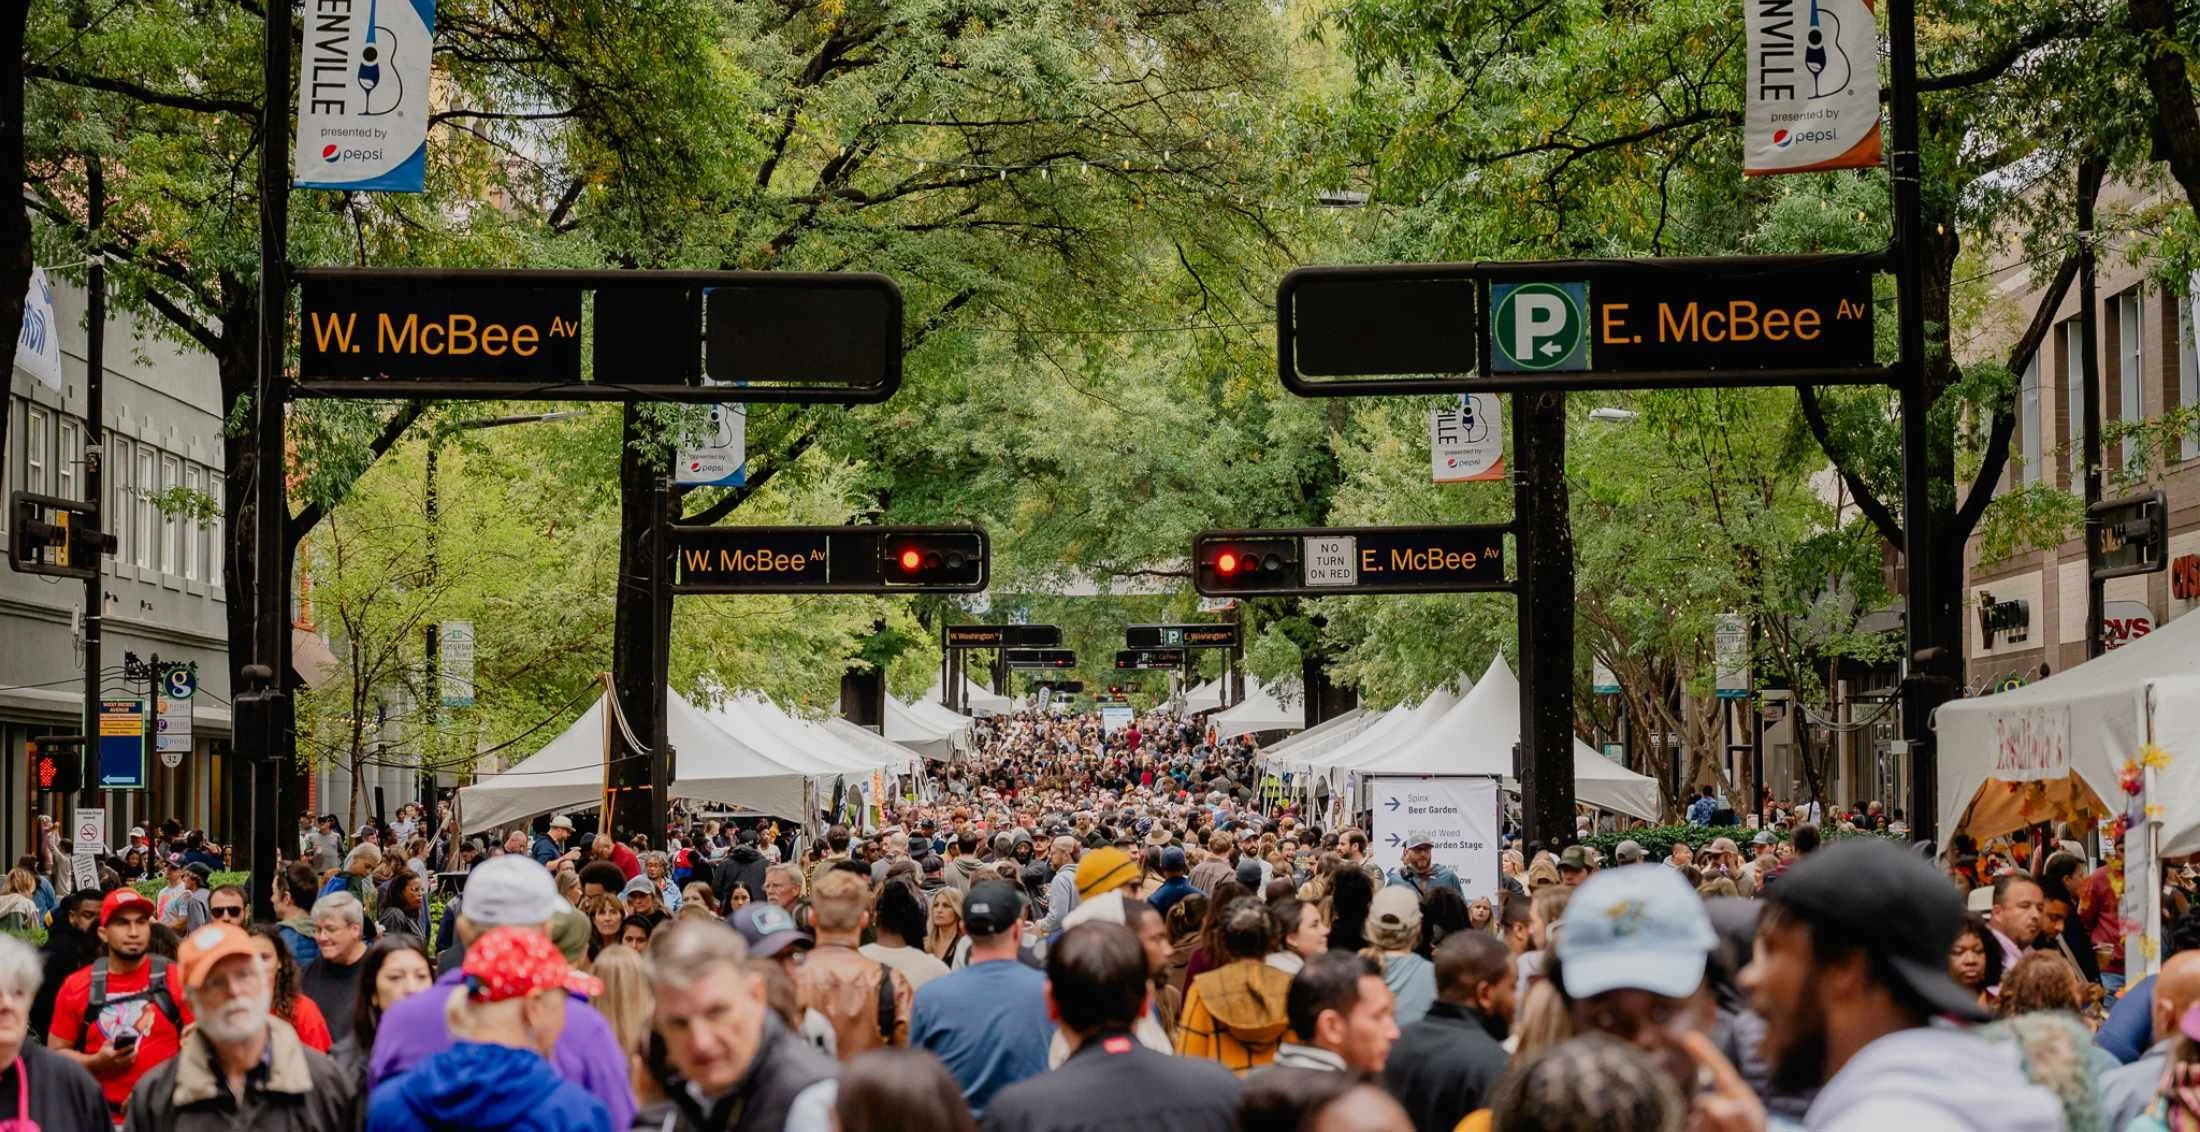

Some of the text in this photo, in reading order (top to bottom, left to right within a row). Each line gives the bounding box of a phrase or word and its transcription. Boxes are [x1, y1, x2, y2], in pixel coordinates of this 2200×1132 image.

[1771, 109, 1839, 122] presented by
[321, 128, 387, 140] presented by
[1796, 128, 1837, 144] pepsi
[343, 148, 384, 162] pepsi
[1514, 293, 1567, 360] P
[1603, 299, 1865, 344] E. McBee Av
[311, 312, 578, 356] W. McBee Av
[1437, 409, 1457, 444] ILLE
[702, 463, 724, 473] pepsi
[1320, 544, 1339, 553] NO
[685, 549, 825, 572] W. McBee Av
[1316, 556, 1345, 566] TURN
[1362, 547, 1499, 571] E. McBee Av
[1311, 569, 1350, 579] ON RED
[1408, 806, 1457, 814] Beer Garden
[1459, 841, 1483, 851] Stage
